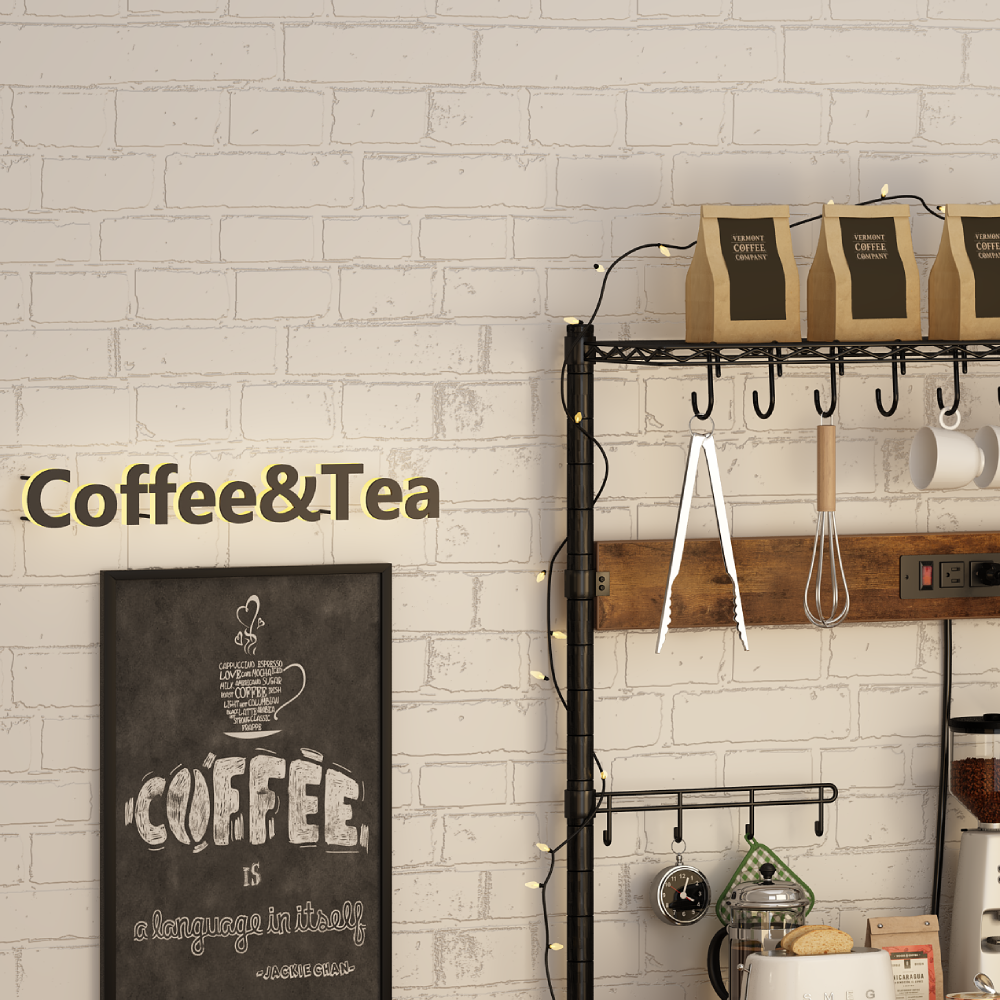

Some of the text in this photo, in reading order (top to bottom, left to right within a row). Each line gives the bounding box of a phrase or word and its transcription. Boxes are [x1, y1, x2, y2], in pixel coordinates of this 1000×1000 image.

[733, 243, 766, 252] COFFEE
[854, 242, 886, 251] COFFEE
[22, 463, 441, 528] Coffee&Tea
[220, 670, 241, 680] LOVE
[252, 669, 272, 677] MOCHA
[262, 677, 282, 685] SUGAR
[235, 686, 267, 699] COFFEE
[134, 750, 364, 850] COFFEE
[242, 862, 262, 887] IS
[133, 901, 366, 956] a language in itself
